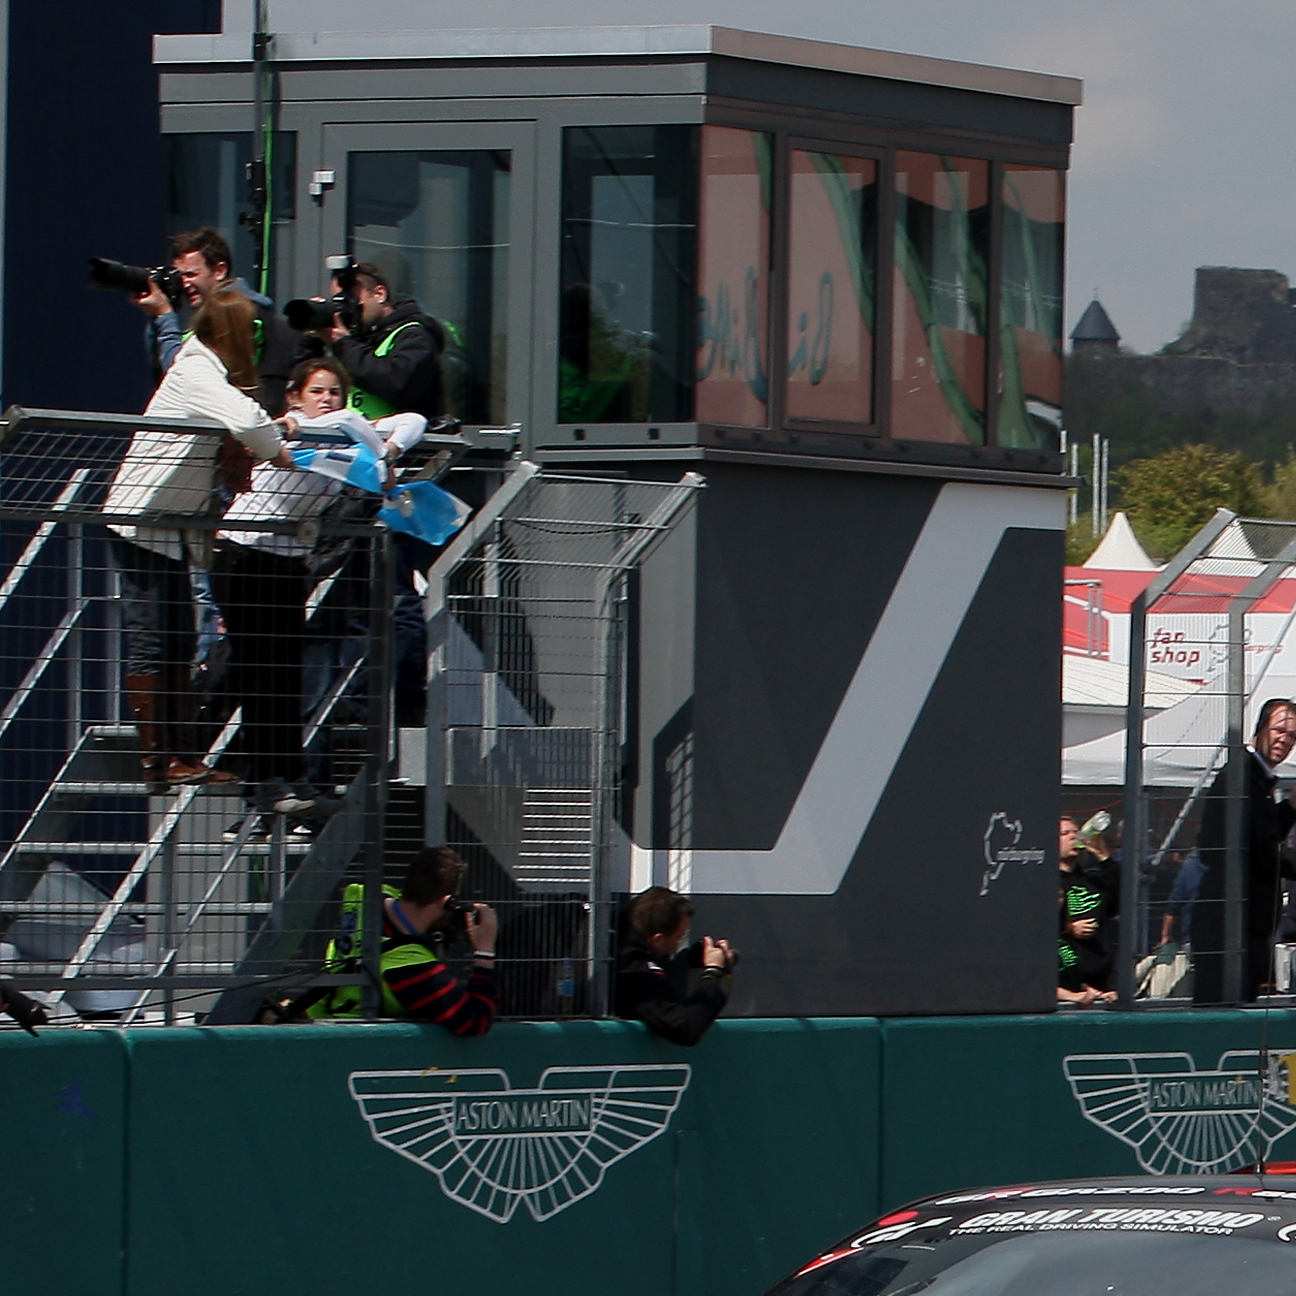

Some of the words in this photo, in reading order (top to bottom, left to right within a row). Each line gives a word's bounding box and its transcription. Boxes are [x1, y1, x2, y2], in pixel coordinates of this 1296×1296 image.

[1149, 627, 1185, 650] fan
[1150, 648, 1200, 667] shop
[1150, 1080, 1201, 1108] ASTON
[456, 1100, 518, 1130] ASTON
[520, 1099, 589, 1128] MARTIN
[950, 1226, 985, 1236] THE
[986, 1223, 1035, 1234] REAL
[1039, 1222, 1119, 1231] DRIVING
[1120, 1222, 1234, 1236] SIMULATOR
[958, 1209, 1084, 1228] GRAN
[1078, 1207, 1266, 1229] TURISMO
